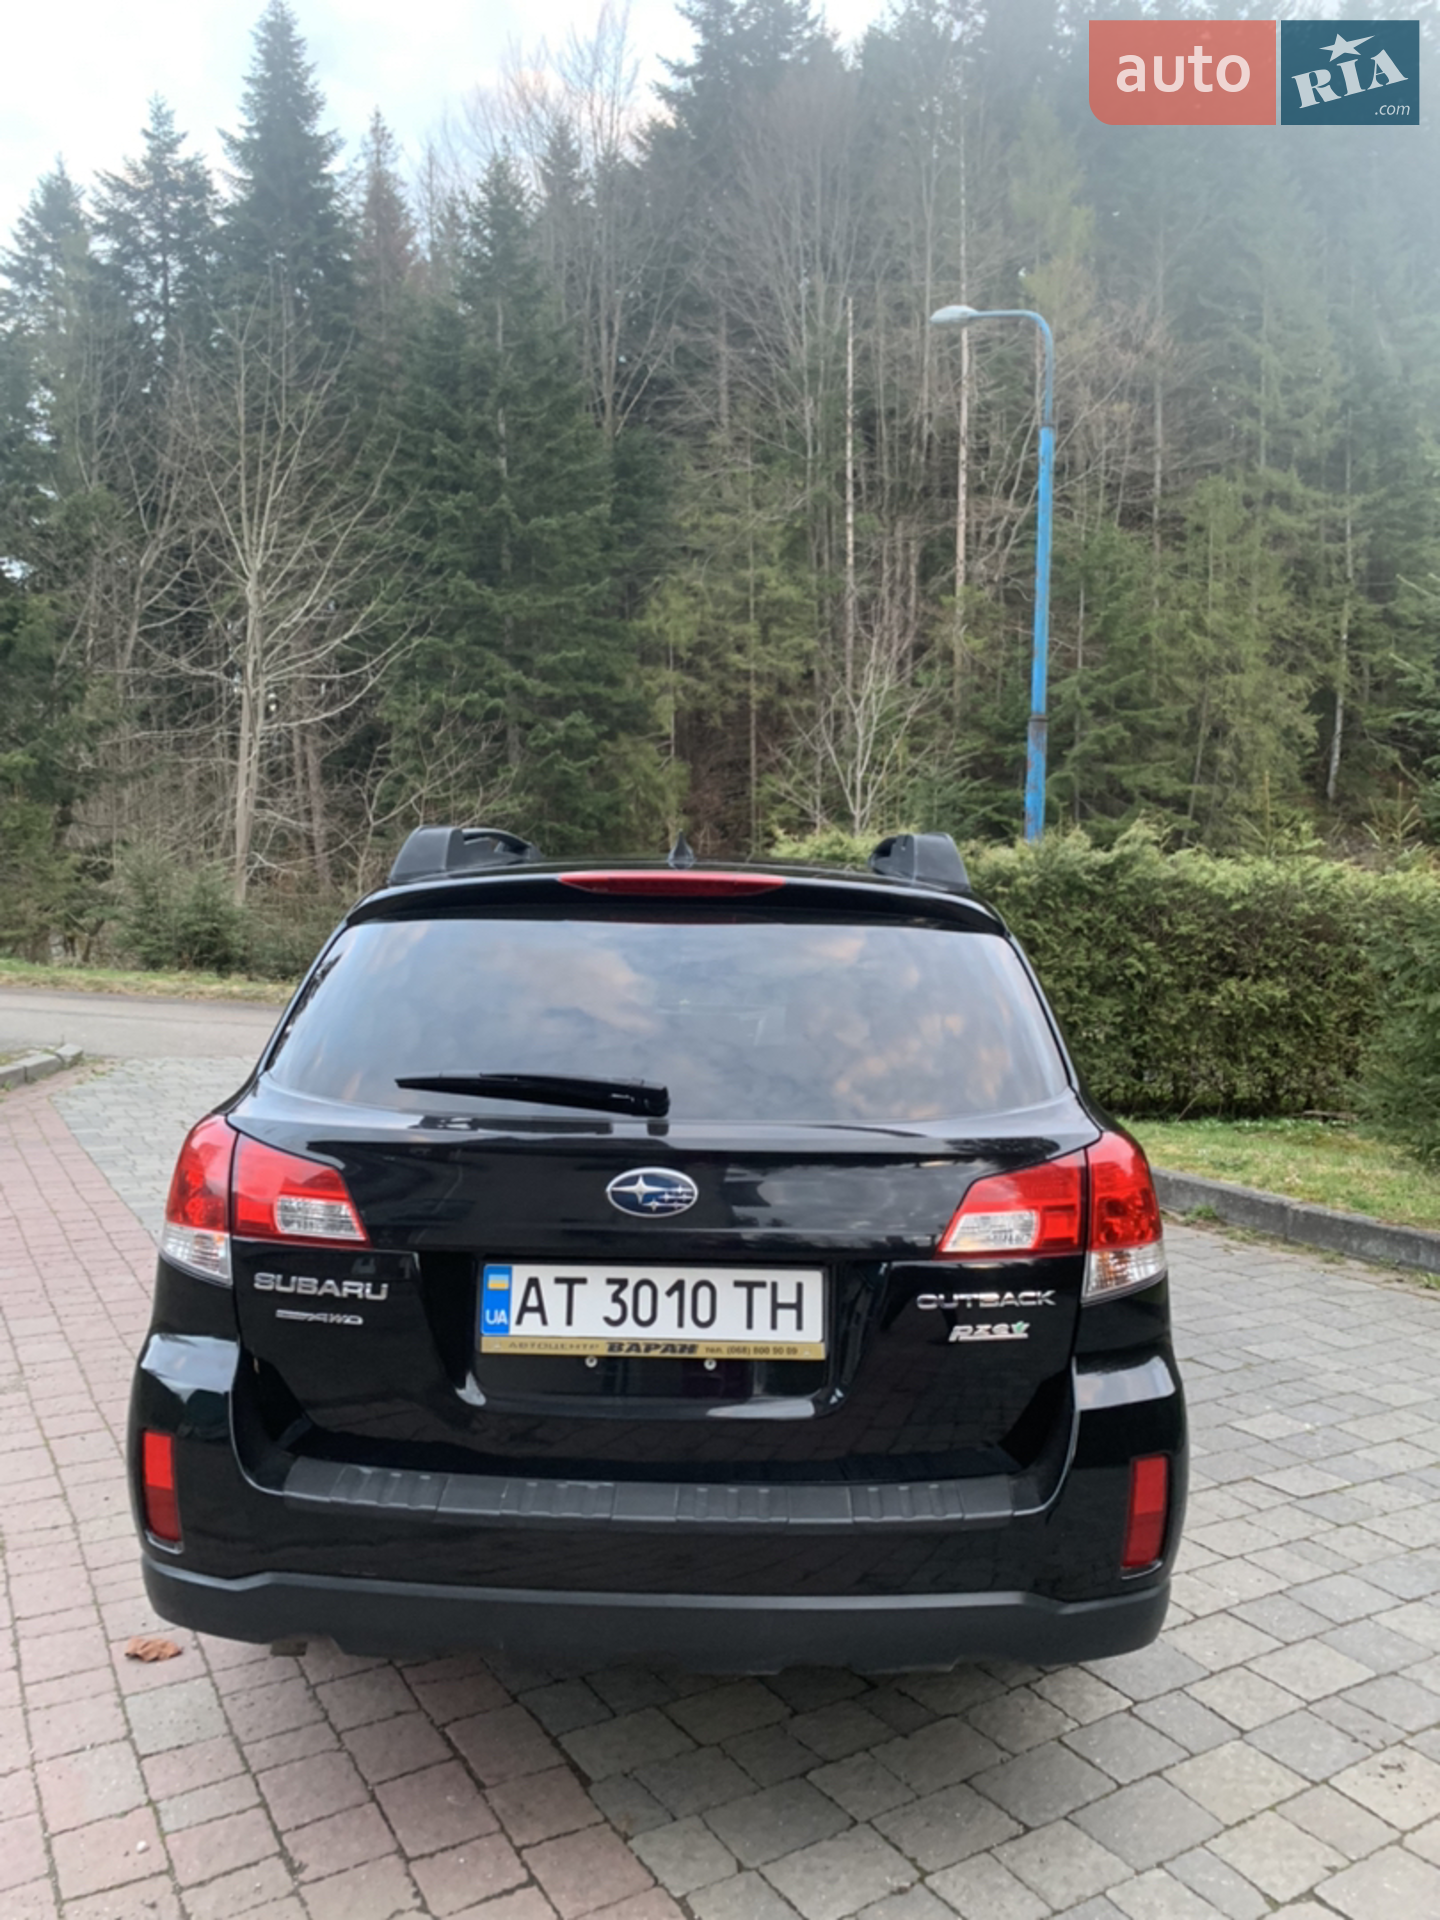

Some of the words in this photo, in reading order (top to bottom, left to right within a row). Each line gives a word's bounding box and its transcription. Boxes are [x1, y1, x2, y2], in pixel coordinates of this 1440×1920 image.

[253, 1272, 389, 1300] SUBARU
[515, 1276, 588, 1327] AT
[602, 1277, 718, 1329] 3010
[733, 1280, 804, 1331] TH
[916, 1290, 1056, 1310] OUTBACK
[485, 1309, 508, 1326] UA
